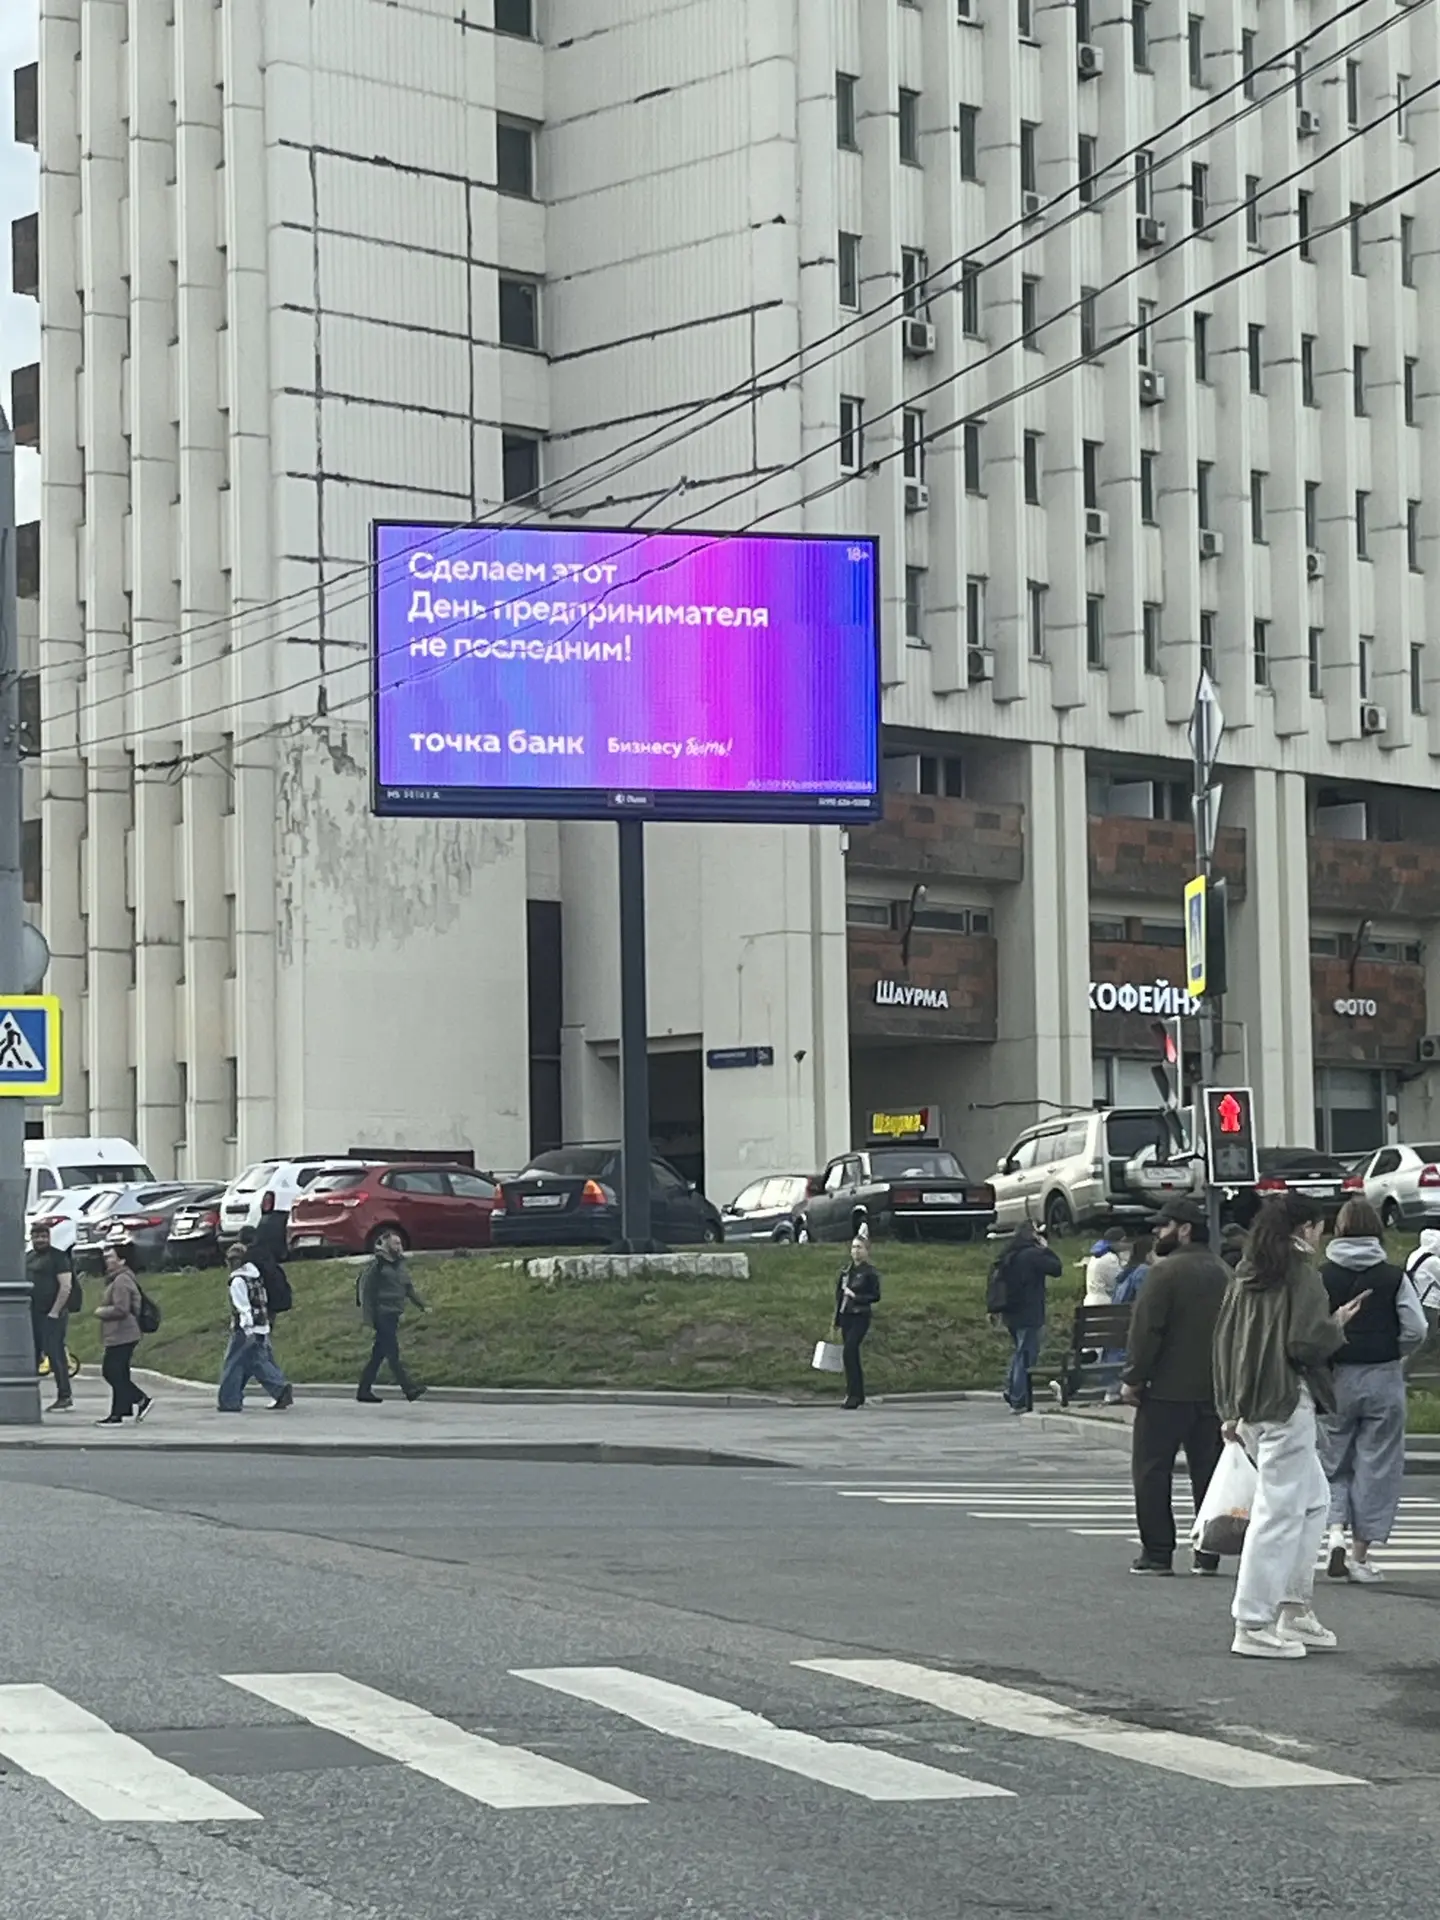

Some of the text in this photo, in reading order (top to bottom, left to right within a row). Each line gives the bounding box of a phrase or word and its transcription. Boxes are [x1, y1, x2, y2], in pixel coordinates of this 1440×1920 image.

[408, 551, 618, 584] Сделаем этот
[407, 589, 769, 630] День предпринимателя
[409, 634, 632, 664] не последним!
[409, 729, 584, 755] точка банк
[607, 737, 682, 758] Бизнесу
[1333, 998, 1377, 1017] ФОТО
